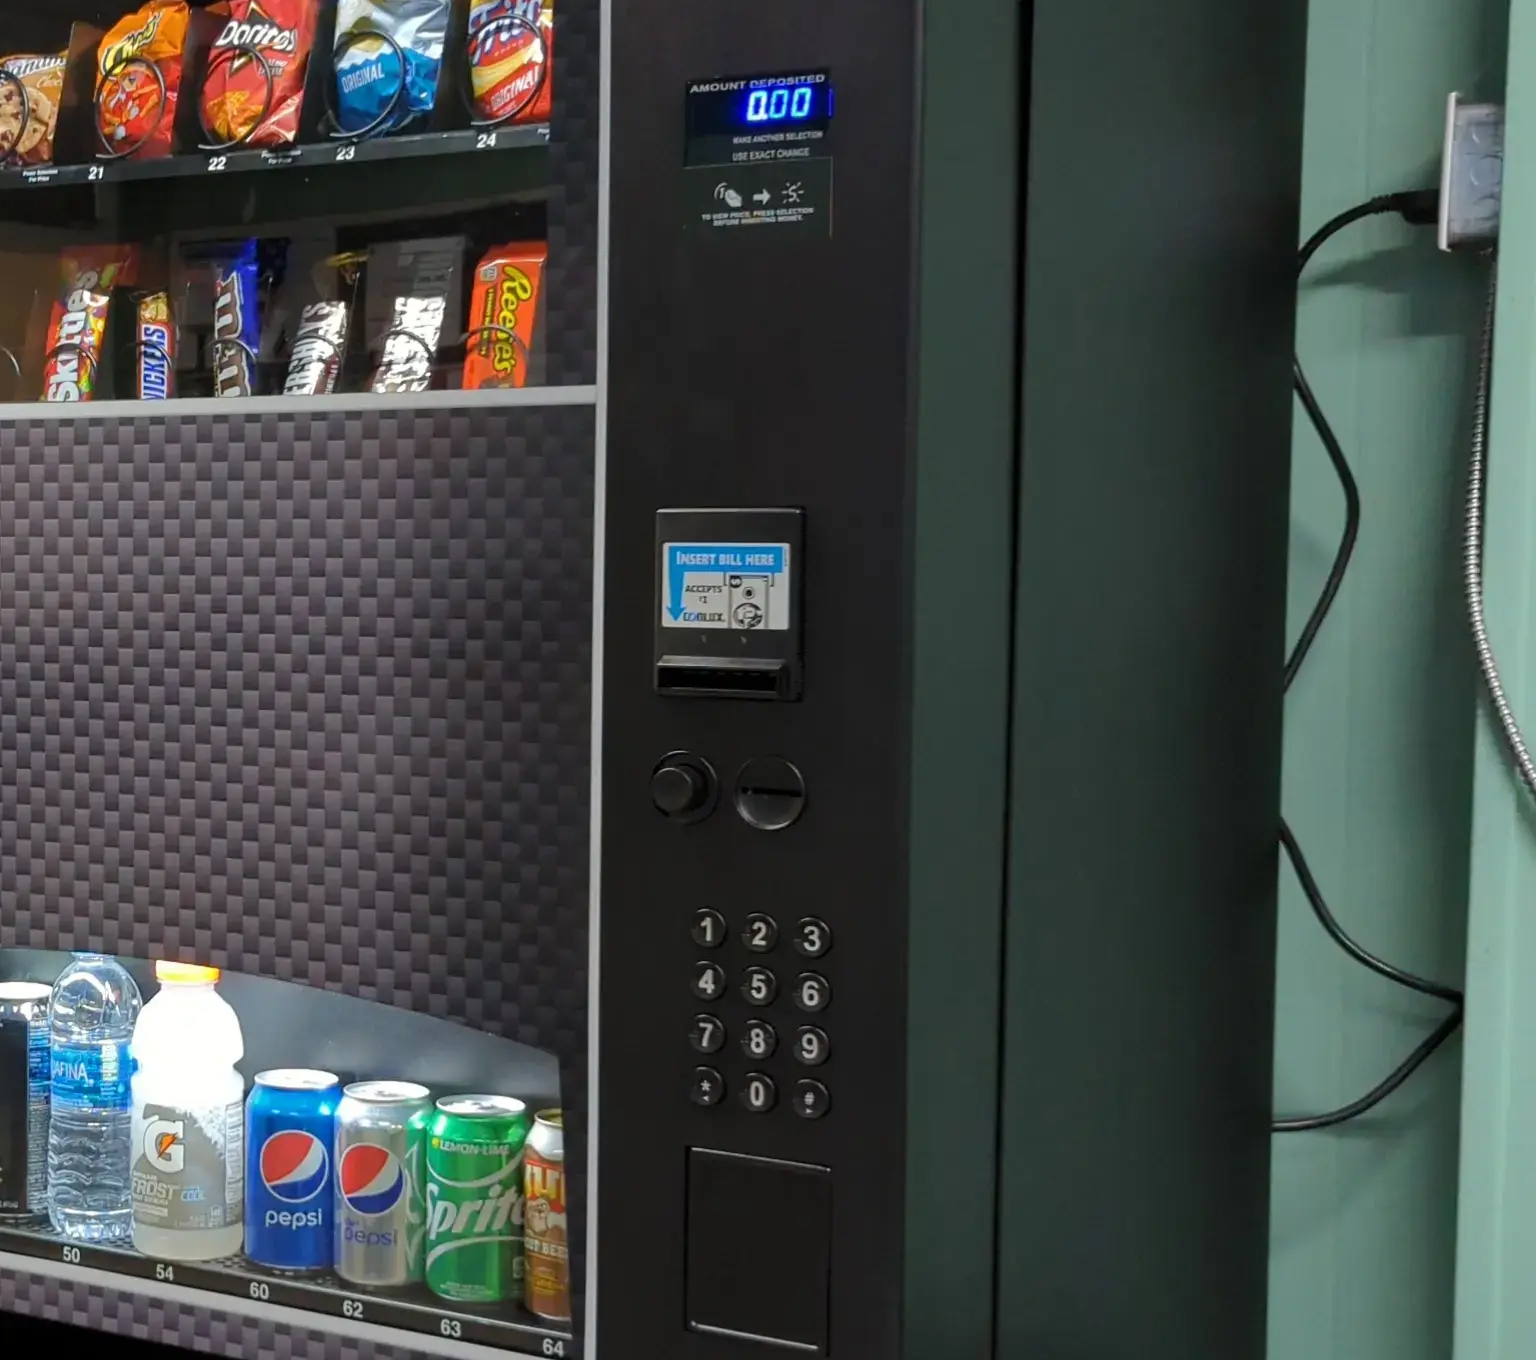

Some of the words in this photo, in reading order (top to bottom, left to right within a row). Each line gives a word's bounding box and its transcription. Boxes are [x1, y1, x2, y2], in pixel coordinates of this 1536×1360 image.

[341, 65, 385, 94] ORIGINAL
[689, 80, 747, 94] AMOUNT
[749, 74, 826, 89] DEPOSITED
[746, 87, 812, 121] 0.00
[476, 134, 497, 148] 24
[785, 130, 824, 141] SELECTION
[336, 147, 355, 161] 23
[732, 151, 748, 162] USE
[749, 149, 776, 160] EXACT
[776, 147, 810, 158] CHANGE
[87, 166, 105, 181] 21
[208, 156, 227, 172] 22
[676, 550, 717, 566] INSERT
[718, 553, 743, 566] BILL
[745, 553, 775, 566] HERE
[685, 585, 723, 593] ACCEPTS
[700, 916, 713, 942] 1
[751, 921, 767, 946] 2
[803, 925, 821, 952] 3
[697, 968, 715, 994] 4
[750, 973, 766, 1000] 5
[801, 980, 820, 1007] 6
[698, 1022, 714, 1048] 7
[750, 1027, 765, 1054] 8
[801, 1032, 818, 1059] 9
[749, 1080, 765, 1107] 0
[143, 1119, 185, 1174] G
[440, 1138, 510, 1156] LEMON-LIME
[132, 1178, 181, 1200] FROST
[265, 1208, 322, 1230] pepsi
[344, 1227, 399, 1247] pepsi
[63, 1247, 81, 1263] 50
[155, 1264, 174, 1281] 54
[249, 1281, 269, 1300] 60
[342, 1299, 363, 1318] 62
[440, 1319, 462, 1337] 63
[542, 1338, 564, 1357] 64
